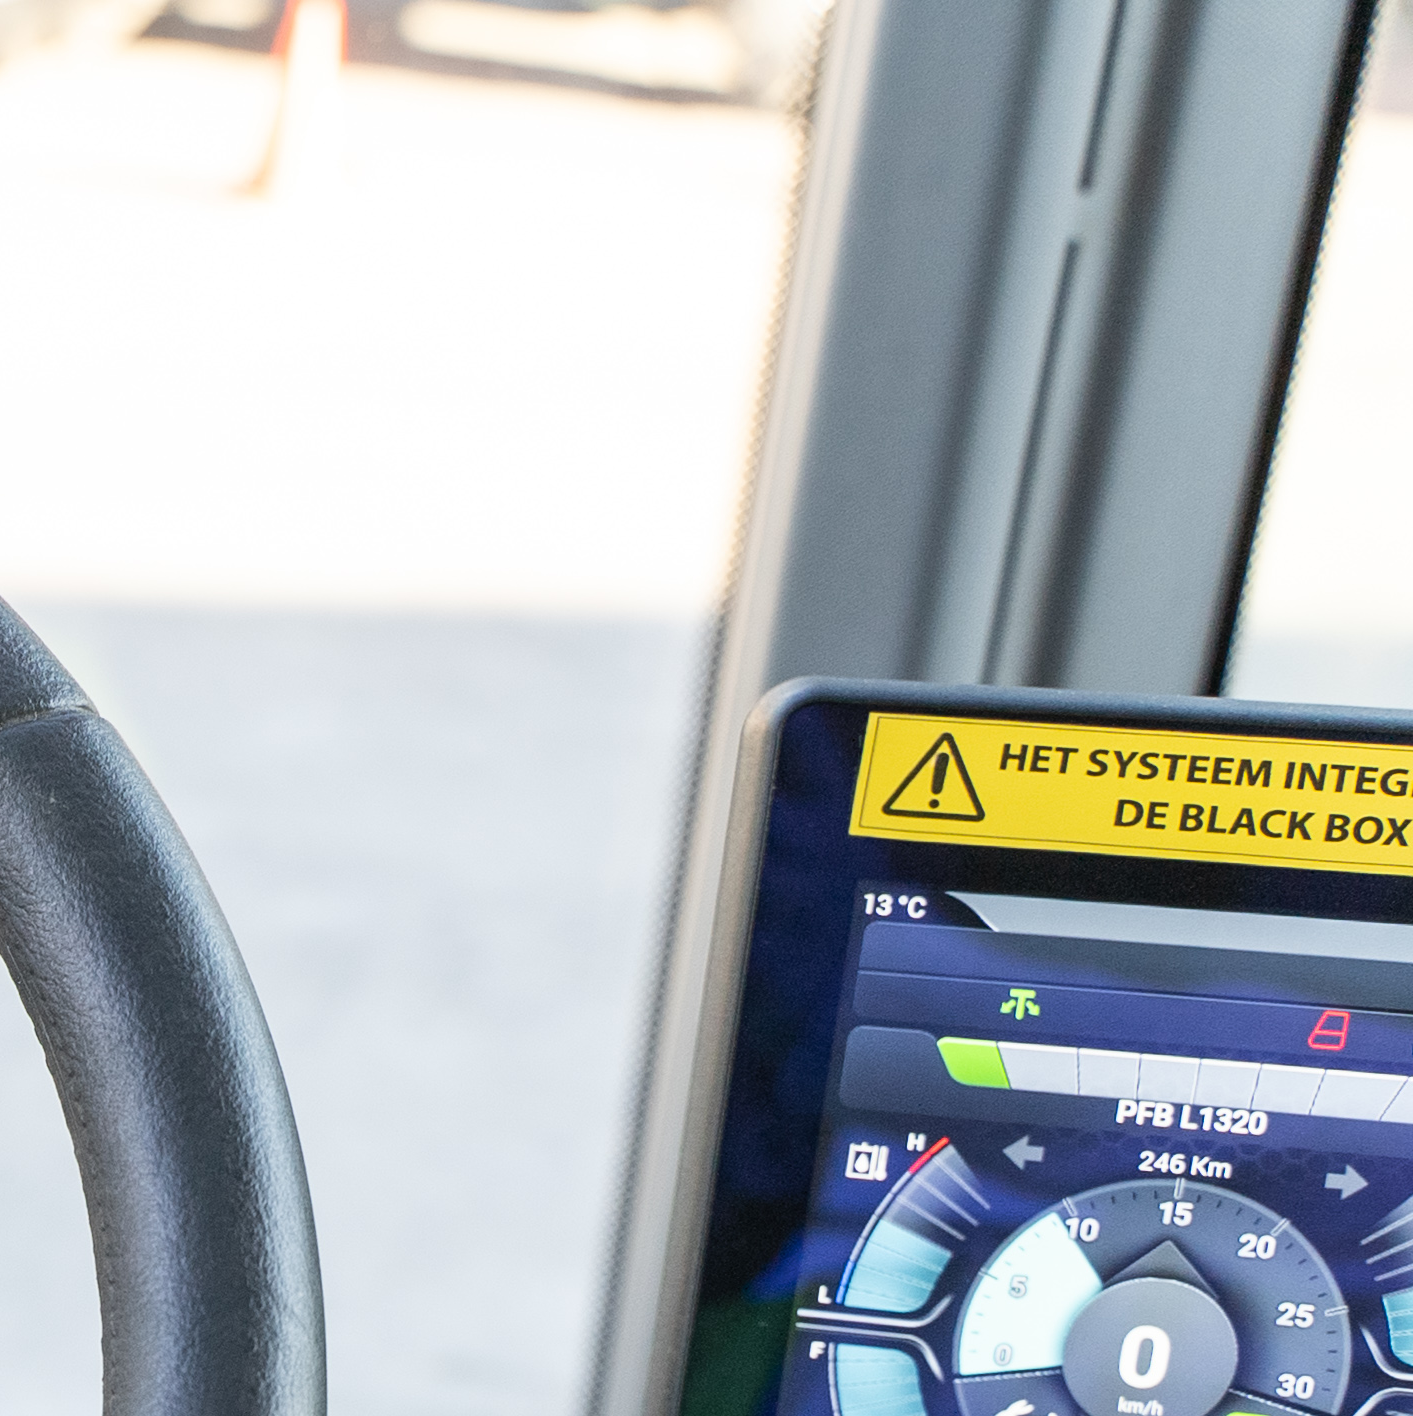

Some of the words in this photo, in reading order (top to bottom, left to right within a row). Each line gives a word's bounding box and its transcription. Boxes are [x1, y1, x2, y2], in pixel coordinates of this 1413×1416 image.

[999, 743, 1078, 775] HET
[1086, 749, 1273, 788] SYSTEEM
[1283, 761, 1413, 798] INTEG
[1114, 799, 1167, 831] DE
[1179, 803, 1315, 841] BLACK
[1324, 813, 1413, 847] BOX
[863, 893, 893, 917] 13
[896, 895, 928, 919] °C
[1115, 1099, 1174, 1128] PFB
[1179, 1104, 1269, 1136] L1320
[906, 1132, 927, 1153] H
[1137, 1150, 1187, 1175] 246
[1189, 1155, 1233, 1179] Km
[1158, 1201, 1195, 1227] 15
[1064, 1217, 1101, 1243] 10
[1237, 1233, 1277, 1260] 20
[816, 1284, 833, 1305] L
[1008, 1275, 1029, 1299] 5
[1275, 1301, 1316, 1328] 25
[808, 1340, 827, 1360] F
[993, 1343, 1013, 1366] 0
[1118, 1324, 1172, 1390] 0
[1275, 1373, 1316, 1400] 30
